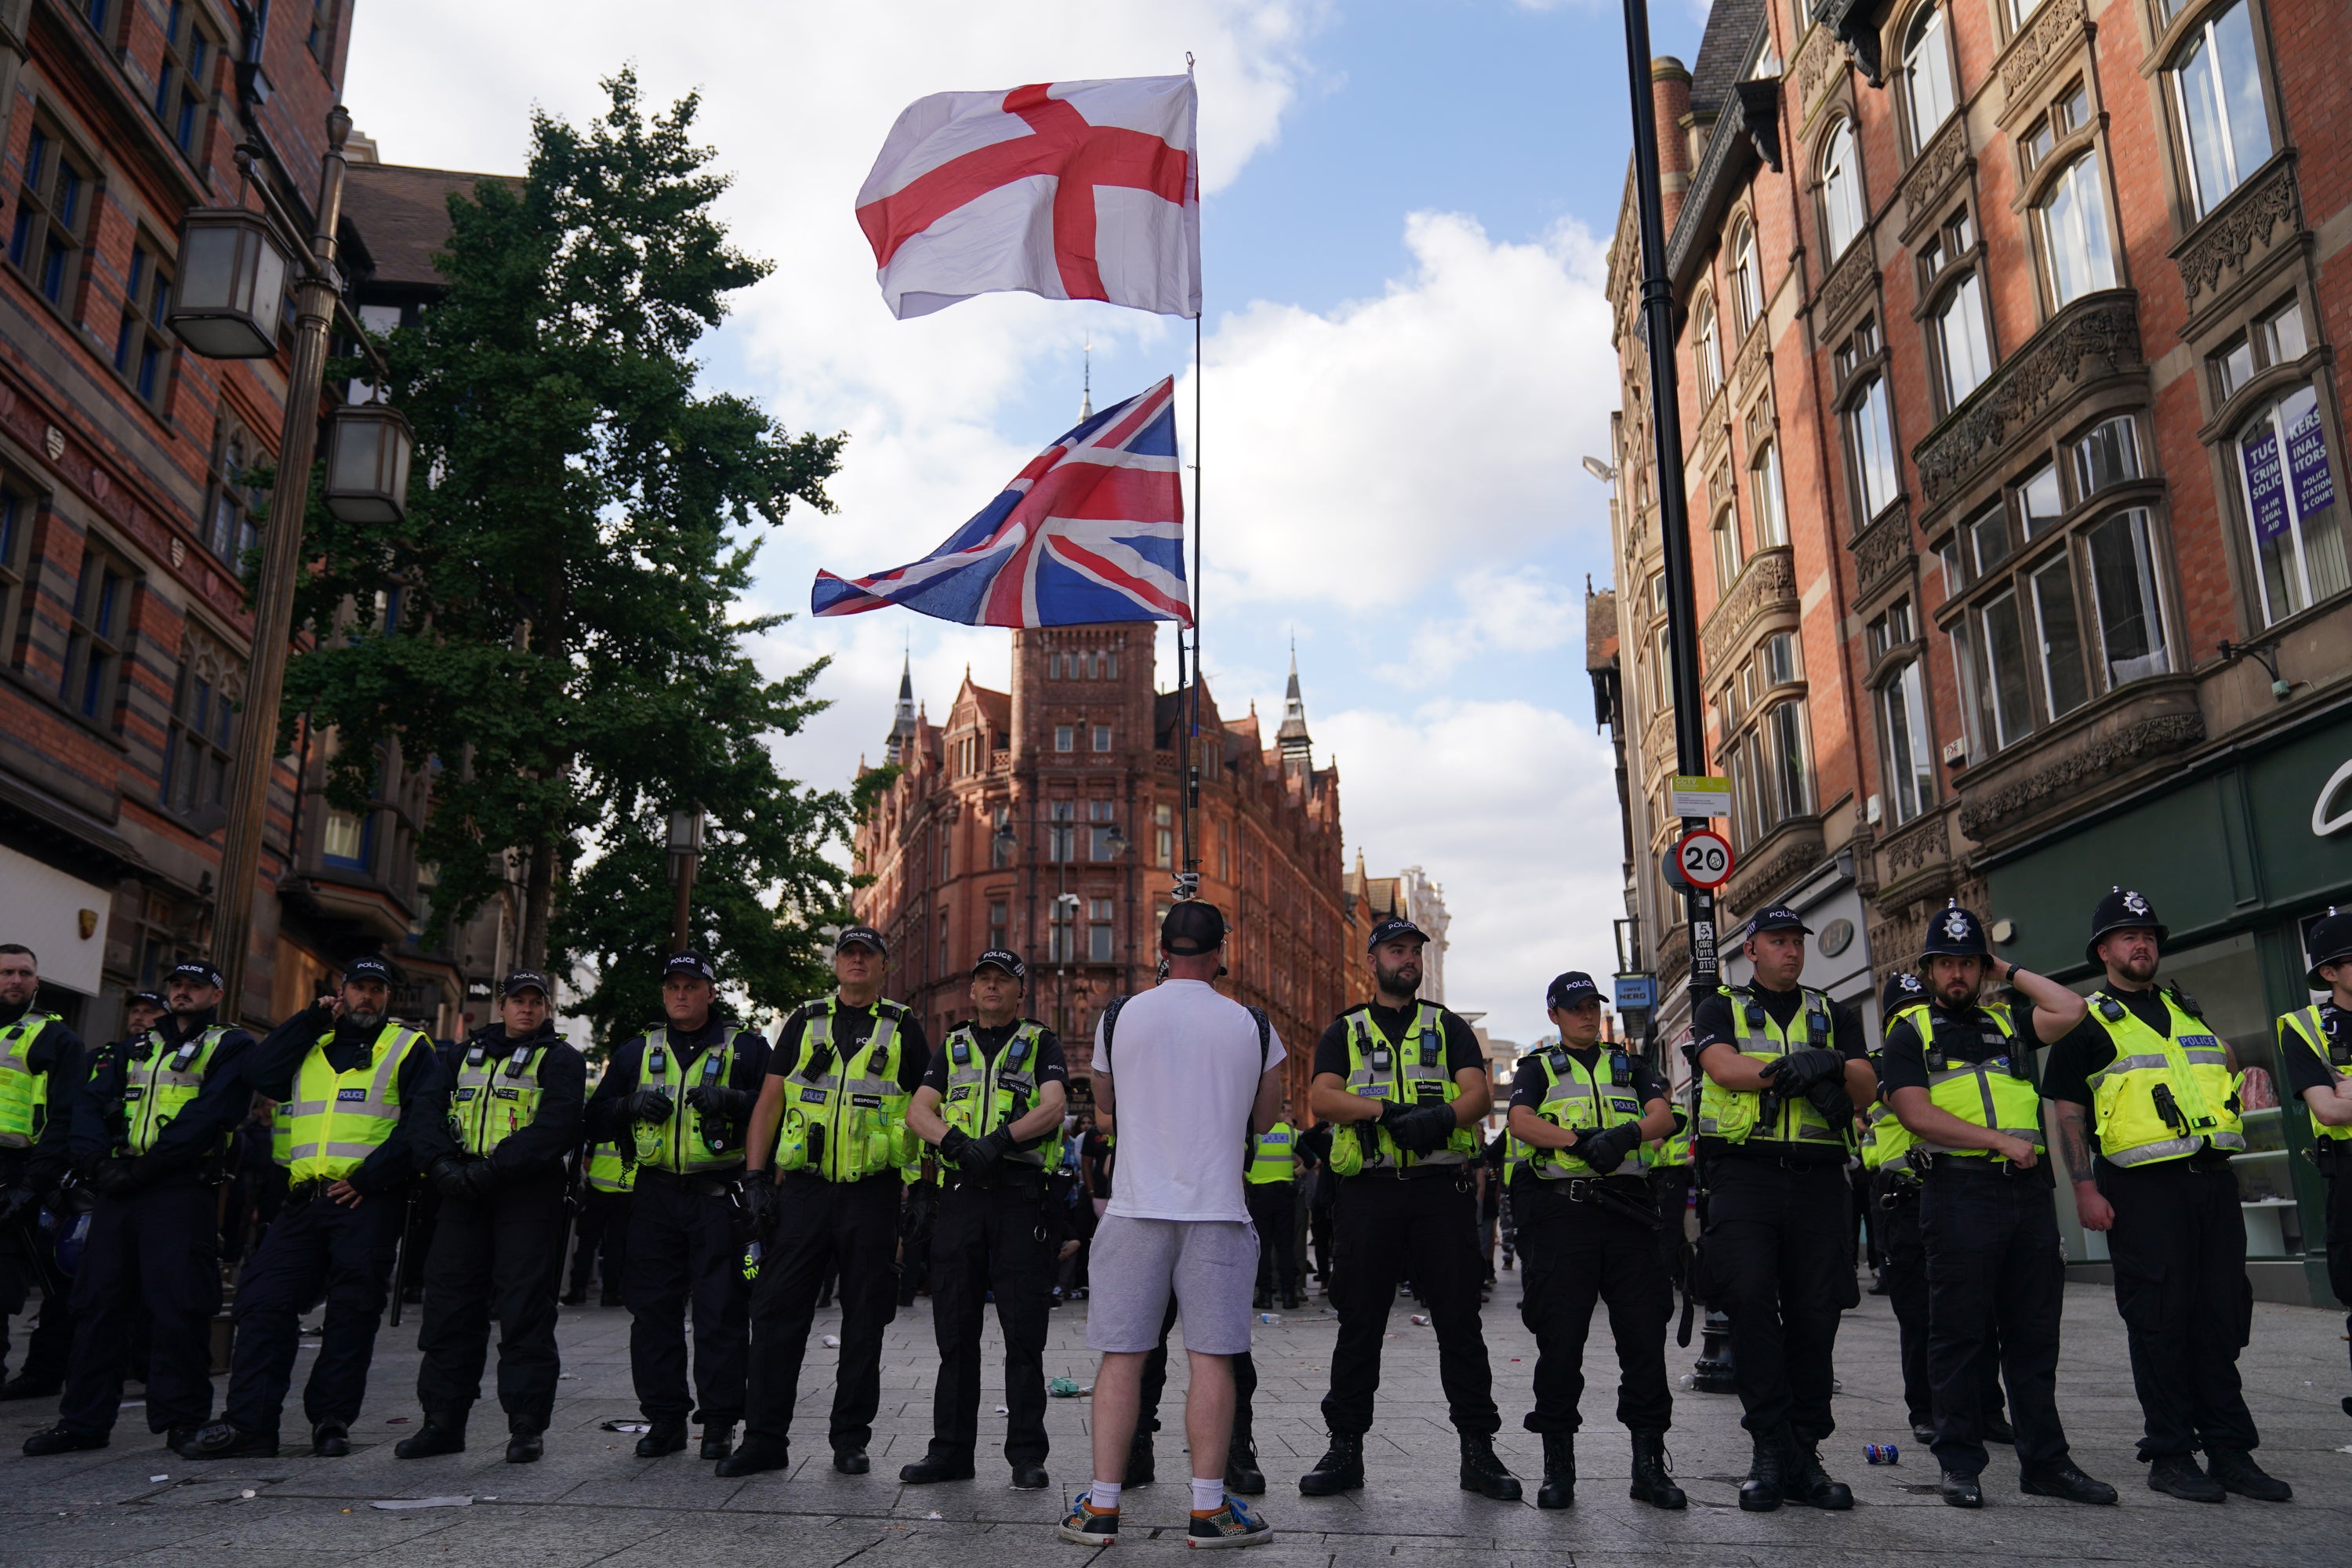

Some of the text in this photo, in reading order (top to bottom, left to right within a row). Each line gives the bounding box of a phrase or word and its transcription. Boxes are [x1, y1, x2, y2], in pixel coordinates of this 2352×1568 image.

[2303, 467, 2327, 489] POLICE
[2302, 477, 2332, 501] STATION
[2303, 487, 2334, 512] & COURT
[2261, 503, 2270, 514] 24
[2270, 497, 2280, 509] HR
[2262, 508, 2282, 533] LEGAL AID
[1686, 847, 1725, 871] 20
[1769, 910, 1798, 920] POLICE
[670, 956, 695, 965] POLICE
[983, 951, 1012, 961] POLICE
[357, 961, 385, 971] POLICE
[1699, 960, 1715, 969] 0115
[1566, 980, 1593, 990] POLICE
[2180, 1036, 2216, 1046] POLICE
[802, 1090, 825, 1102] POLICE
[1613, 1100, 1636, 1110] POLICE
[1262, 1133, 1289, 1142] POLICE
